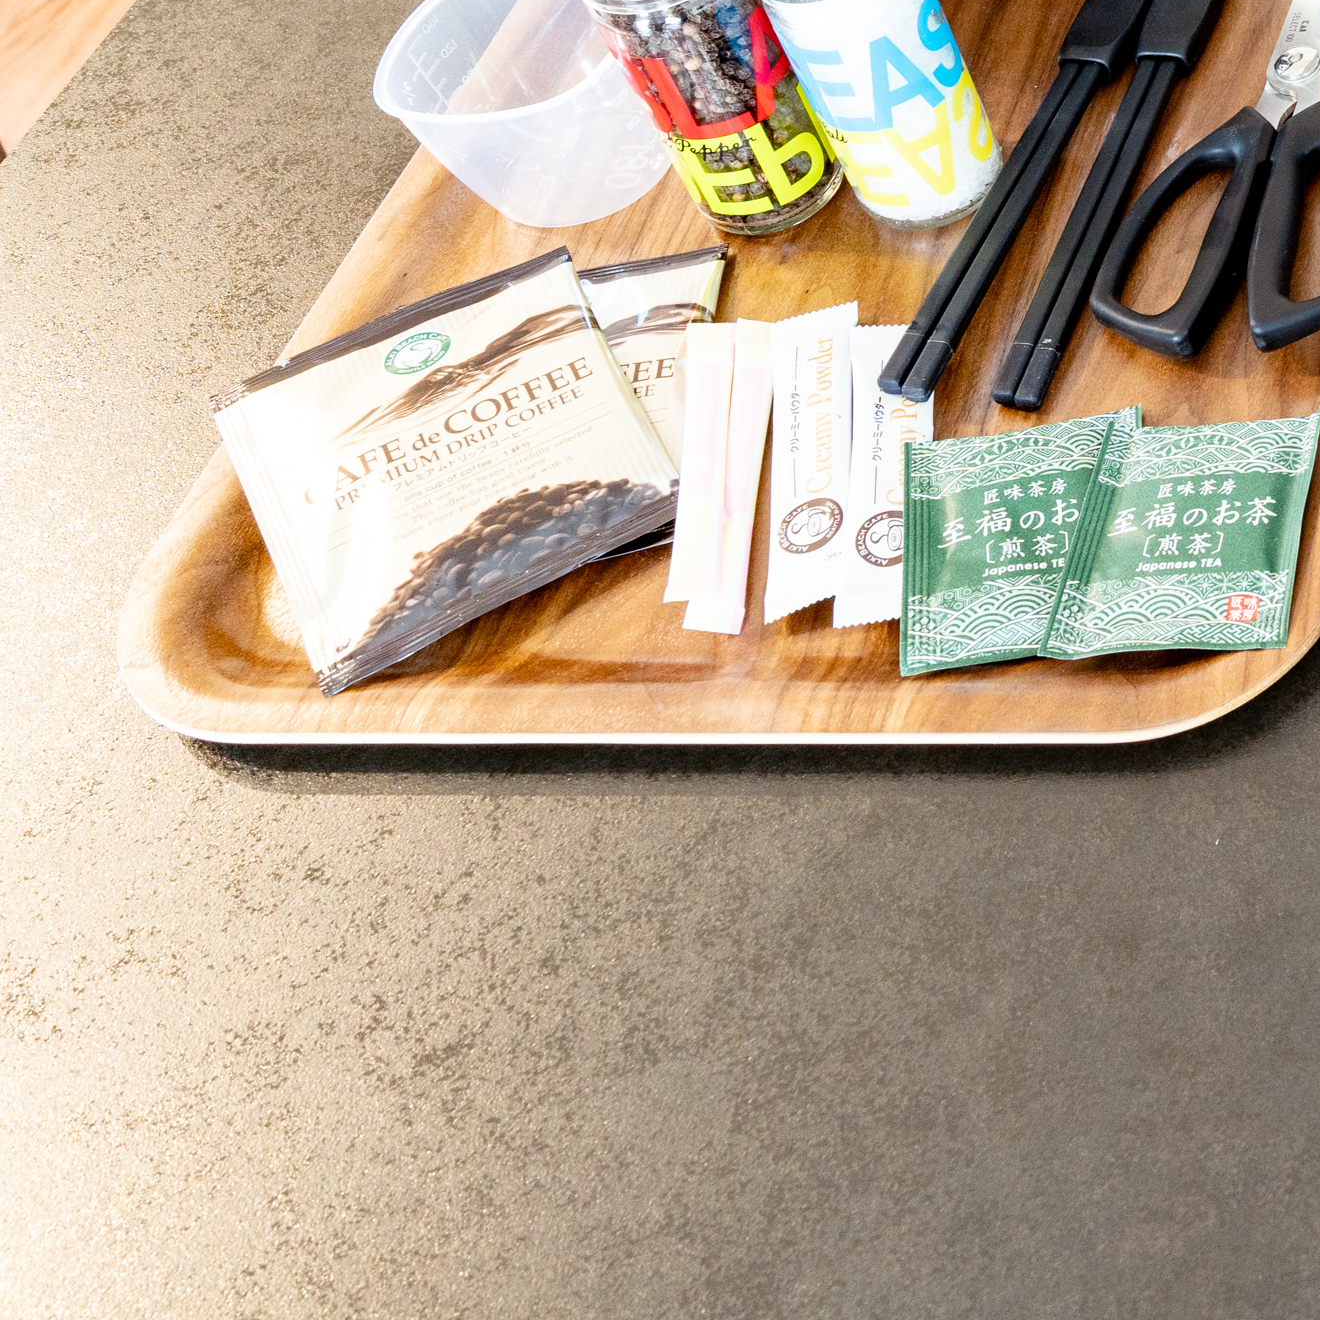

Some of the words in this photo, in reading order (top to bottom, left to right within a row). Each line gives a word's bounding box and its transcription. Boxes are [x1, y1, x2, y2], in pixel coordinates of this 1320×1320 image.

[1288, 12, 1301, 32] SELECT
[675, 136, 757, 162] Pepper
[396, 334, 427, 350] BEACH
[807, 336, 834, 406] Powder
[326, 437, 408, 491] AFE
[408, 425, 442, 452] de
[440, 354, 594, 438] COFFEE
[790, 384, 801, 453] クリーミーパウダー
[872, 396, 884, 461] クリーミーパウダー
[331, 448, 444, 511] PRMIUM
[445, 422, 501, 455] DRIP
[503, 385, 584, 429] COFFEE
[392, 424, 533, 492] プレミアムドリップコーヒー
[410, 497, 434, 513] that
[475, 465, 505, 483] beans
[506, 444, 552, 471] carefully
[552, 424, 596, 448] selected.
[806, 411, 842, 494] Creamy
[403, 488, 424, 502] one
[425, 479, 444, 494] cup
[459, 456, 492, 477] coffee
[410, 507, 435, 523] This
[436, 492, 468, 511] coffee
[490, 471, 516, 488] good
[426, 508, 457, 528] enjoy
[457, 496, 482, 514] your
[483, 483, 508, 500] time
[509, 470, 539, 489] along
[538, 458, 562, 474] with
[983, 478, 1068, 506] 匠味茶房
[1157, 479, 1237, 499] 匠味茶房
[785, 503, 809, 521] CAFE
[864, 513, 889, 528] CAFE
[937, 498, 1080, 549] 至福のお
[1107, 495, 1278, 538] 至福のお茶
[982, 560, 1048, 577] Japanese
[1051, 558, 1066, 570] TE
[1136, 559, 1197, 573] Japanese
[1200, 557, 1222, 569] TEA
